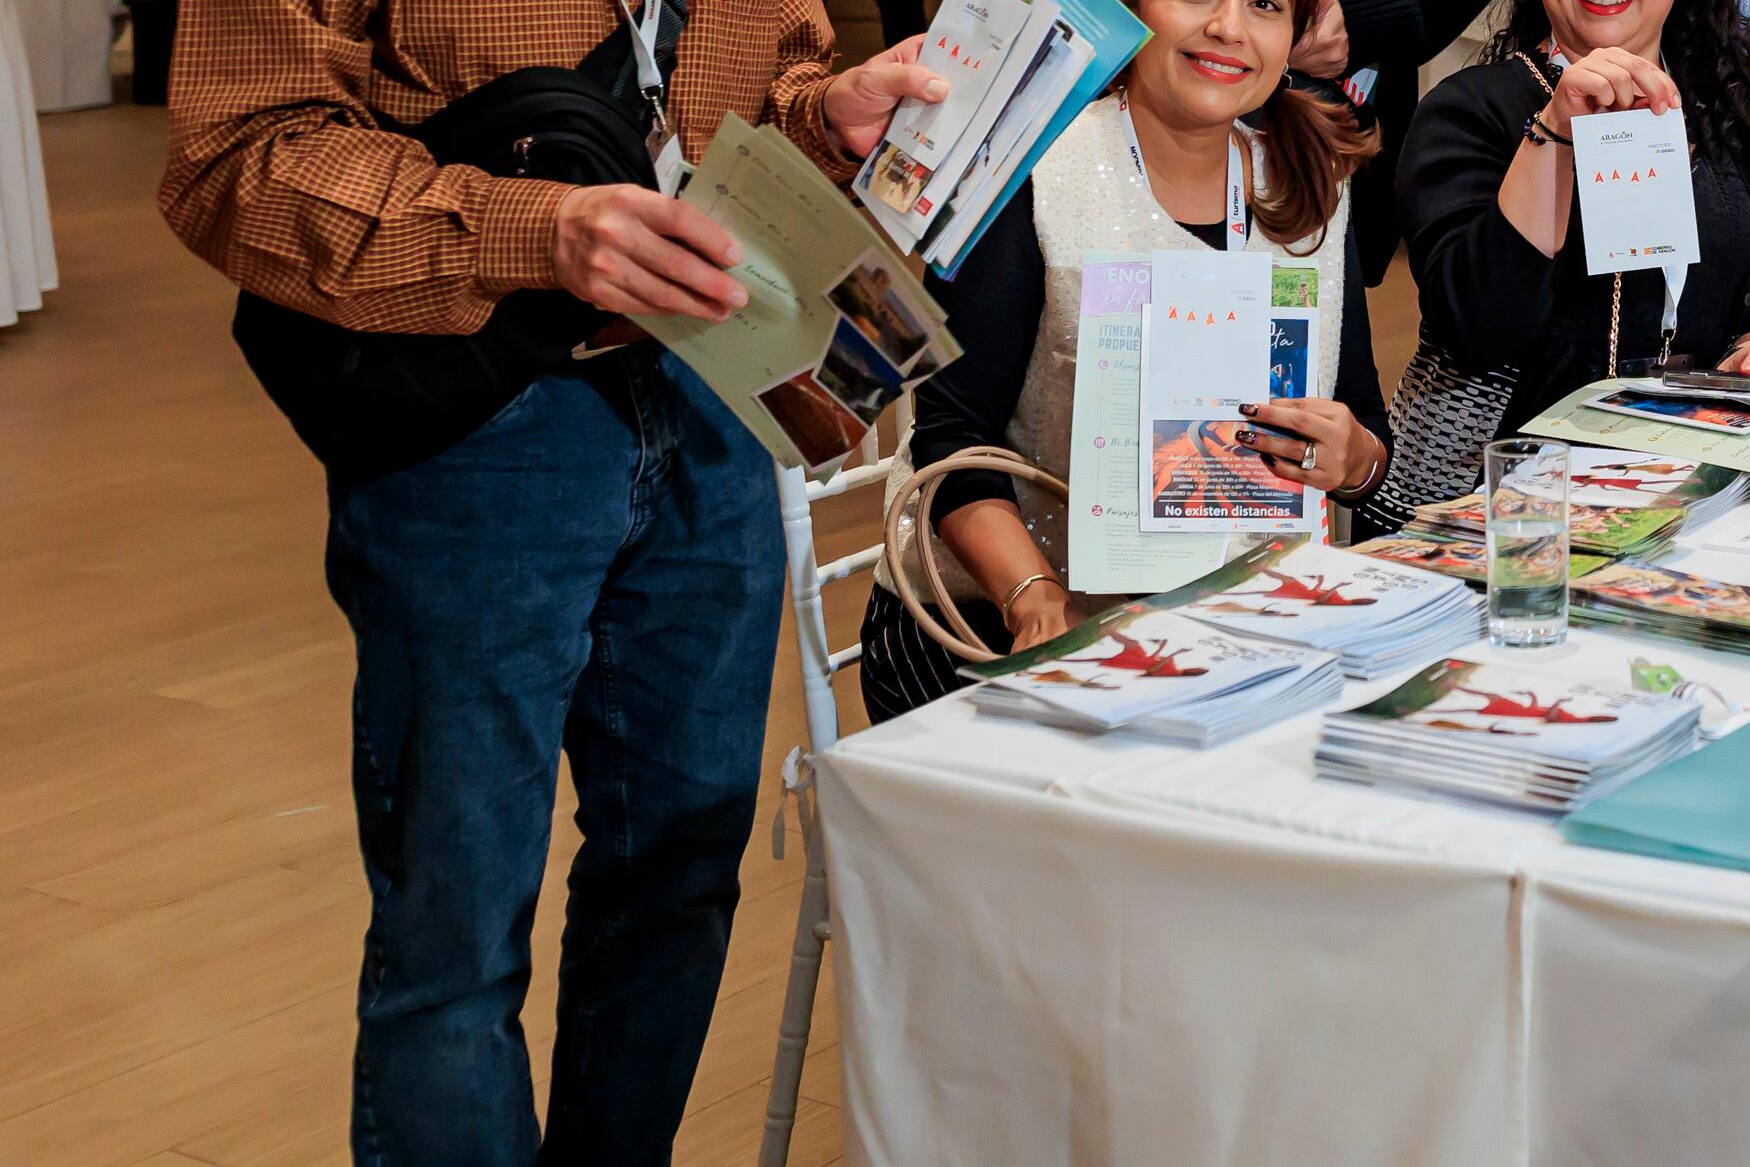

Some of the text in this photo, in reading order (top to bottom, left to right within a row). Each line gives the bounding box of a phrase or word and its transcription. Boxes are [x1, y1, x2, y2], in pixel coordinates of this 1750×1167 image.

[1600, 131, 1633, 142] ARAGÓN
[1099, 324, 1140, 337] ITINERA
[1098, 338, 1140, 352] PROPUE
[1165, 504, 1291, 517] No existen distancias
